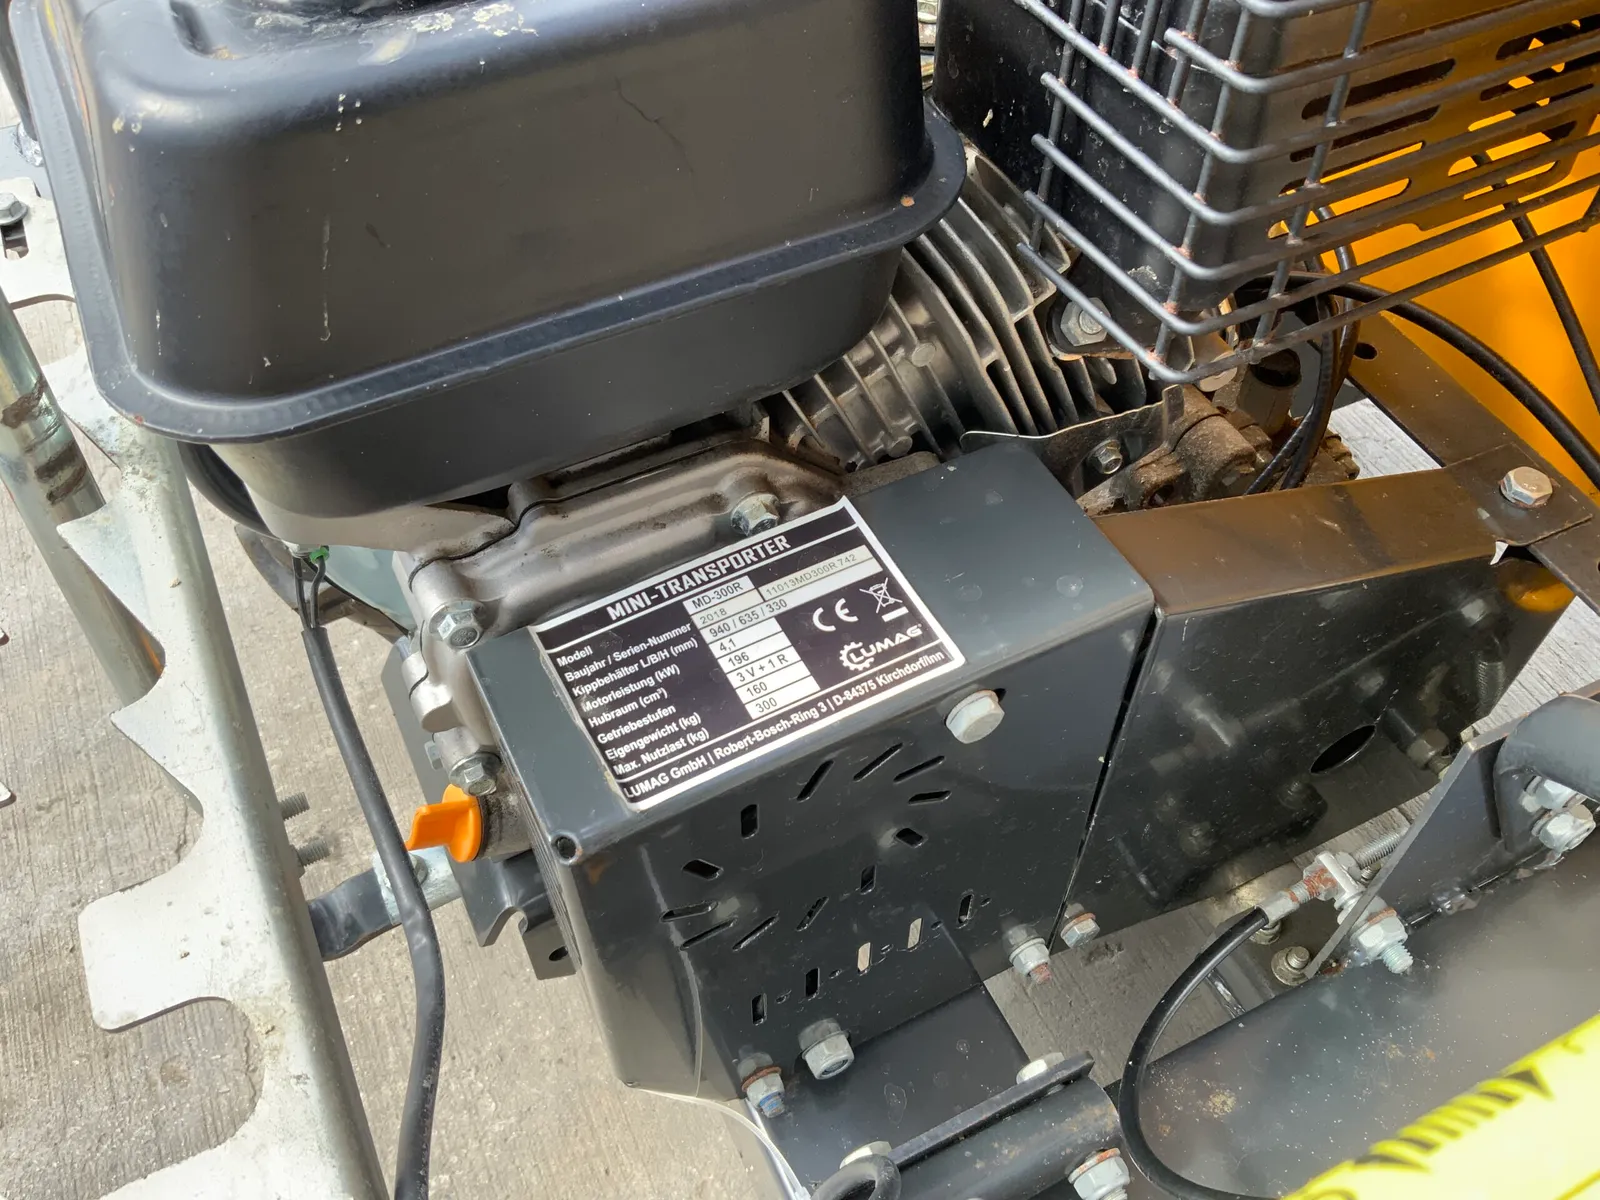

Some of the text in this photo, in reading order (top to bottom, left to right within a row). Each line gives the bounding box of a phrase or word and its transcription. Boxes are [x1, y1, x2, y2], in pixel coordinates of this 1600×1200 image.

[606, 535, 791, 620] MINI-TRANSPORTER
[766, 553, 857, 597] 11013MD300R 742
[691, 582, 743, 609] MD-300R
[700, 608, 727, 625] 2018
[709, 623, 731, 638] 940
[738, 610, 760, 626] 635
[767, 598, 788, 614] 330
[556, 646, 593, 667] Modell
[564, 659, 606, 682] Baujahr
[613, 623, 692, 662] Serien-Nummer
[719, 637, 738, 652] 4,1
[727, 651, 749, 667] 196
[572, 637, 698, 697] Kippbehälter L/B/H (mm)
[736, 672, 746, 682] 3
[745, 668, 755, 678] V
[768, 659, 776, 669] 1
[776, 654, 788, 665] R
[581, 664, 680, 712] Motorleistung (kW)
[746, 681, 768, 697] 160
[755, 697, 778, 713] 300
[588, 702, 638, 728] Hubraum
[597, 705, 676, 744] Getriebestufen
[624, 772, 669, 799] LUMAG
[669, 757, 708, 779] GmbH
[713, 708, 820, 760] Robert-Bosch-Ring
[819, 701, 827, 712] 3
[832, 681, 877, 708] D-84375
[876, 651, 945, 688] Kirchdorf/Inn
[605, 712, 702, 760] Eigengewicht (kg)
[613, 727, 710, 776] Max. Nutzlast (kg)
